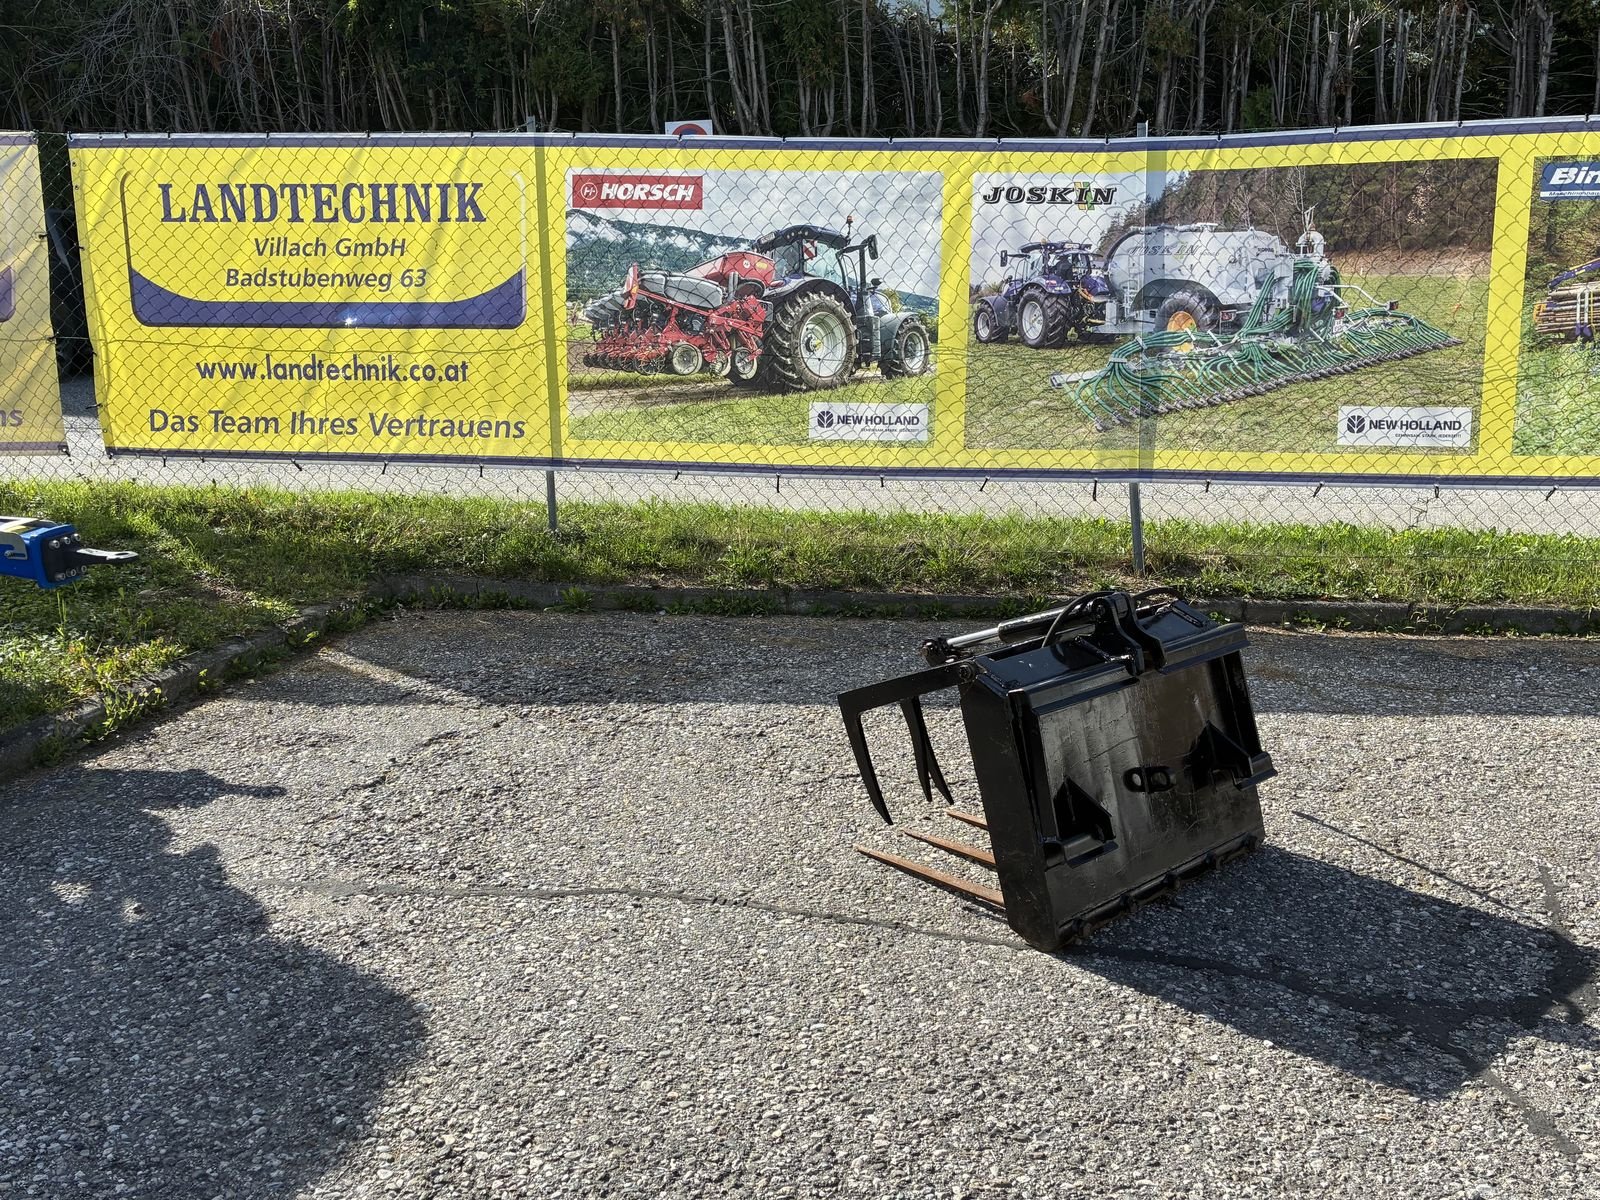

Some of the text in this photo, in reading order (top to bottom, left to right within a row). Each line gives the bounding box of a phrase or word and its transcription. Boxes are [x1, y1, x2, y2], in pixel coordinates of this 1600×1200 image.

[600, 182, 695, 201] HORSCH
[983, 186, 1117, 205] JOSKIN
[158, 182, 487, 224] LANDTECHNIK
[254, 237, 406, 257] Villach GmbH
[225, 268, 427, 292] Badstubenweg 63
[195, 353, 469, 382] www.landtechnik.co.at
[149, 409, 526, 439] Das Team Ihres Vertrauens
[836, 415, 920, 426] NEW HOLLAND
[1369, 419, 1462, 431] NEW HOLLAND
